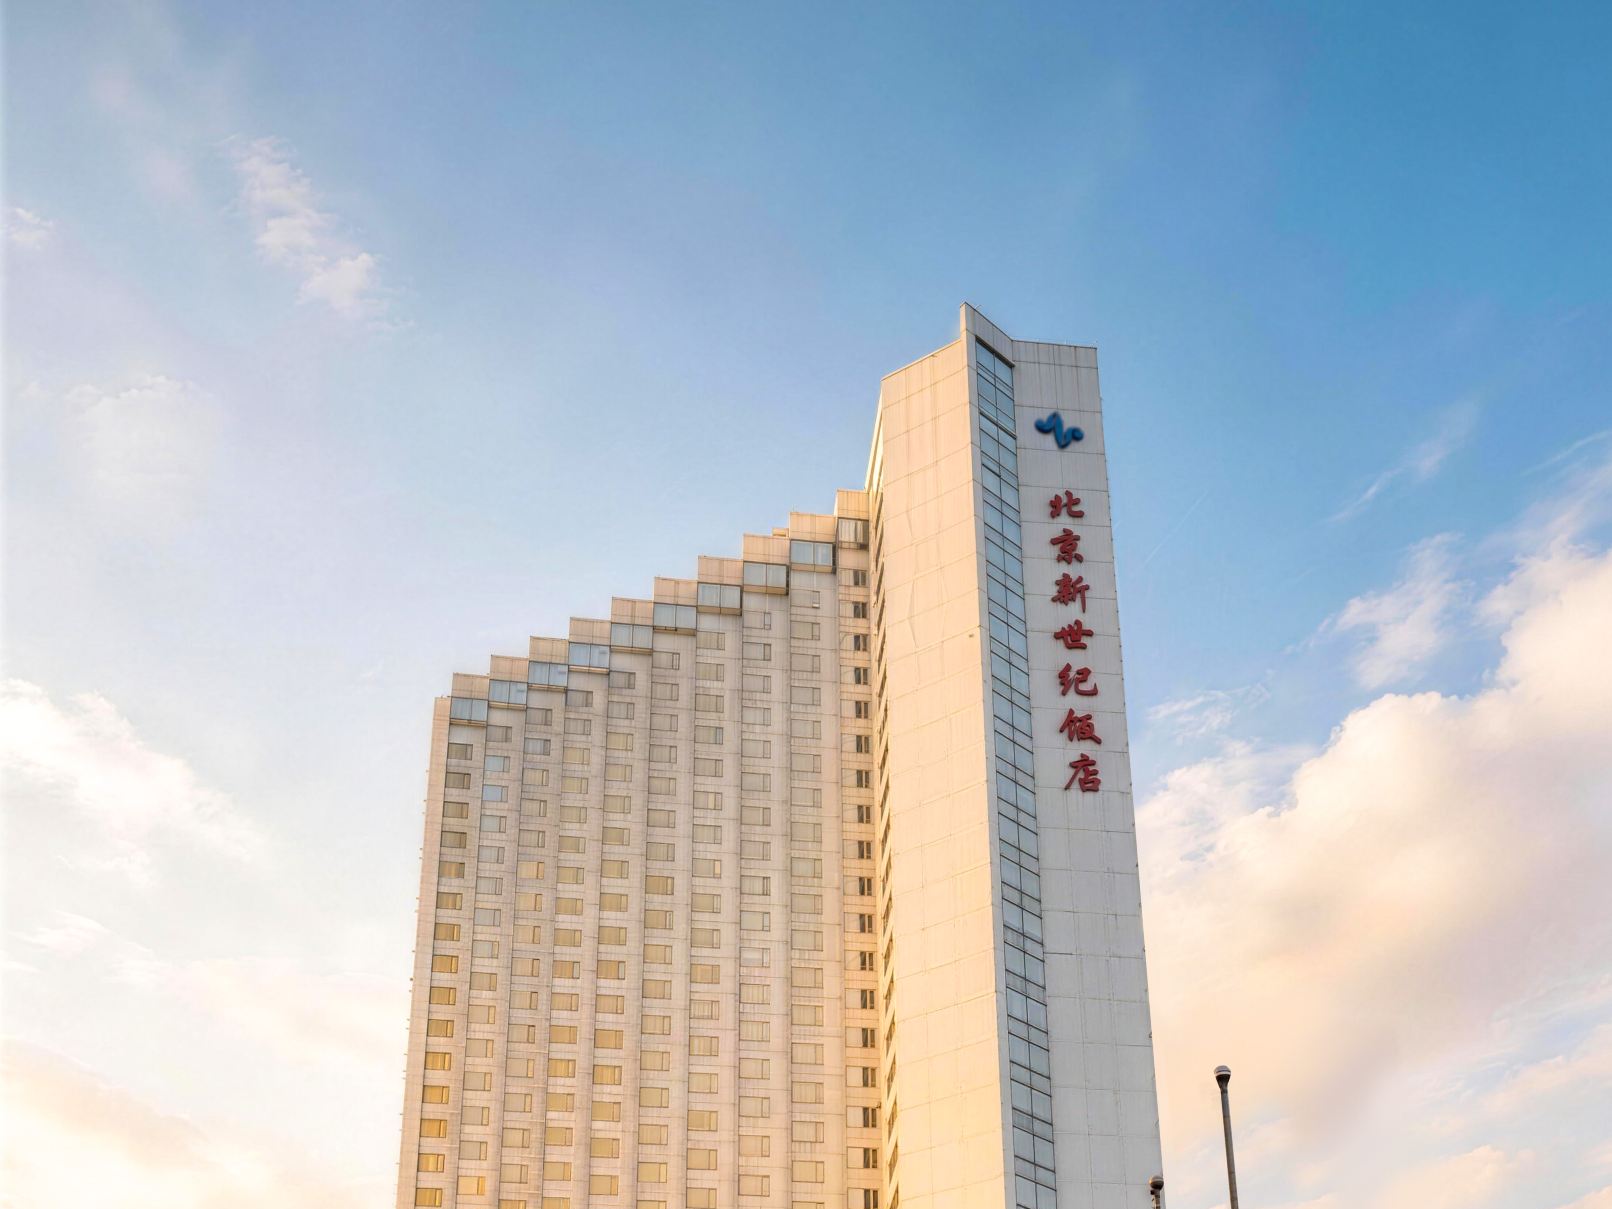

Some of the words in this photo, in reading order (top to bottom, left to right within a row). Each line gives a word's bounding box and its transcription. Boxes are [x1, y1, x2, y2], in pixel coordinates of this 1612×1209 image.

[1048, 490, 1102, 793] 北京新世纪饭店
